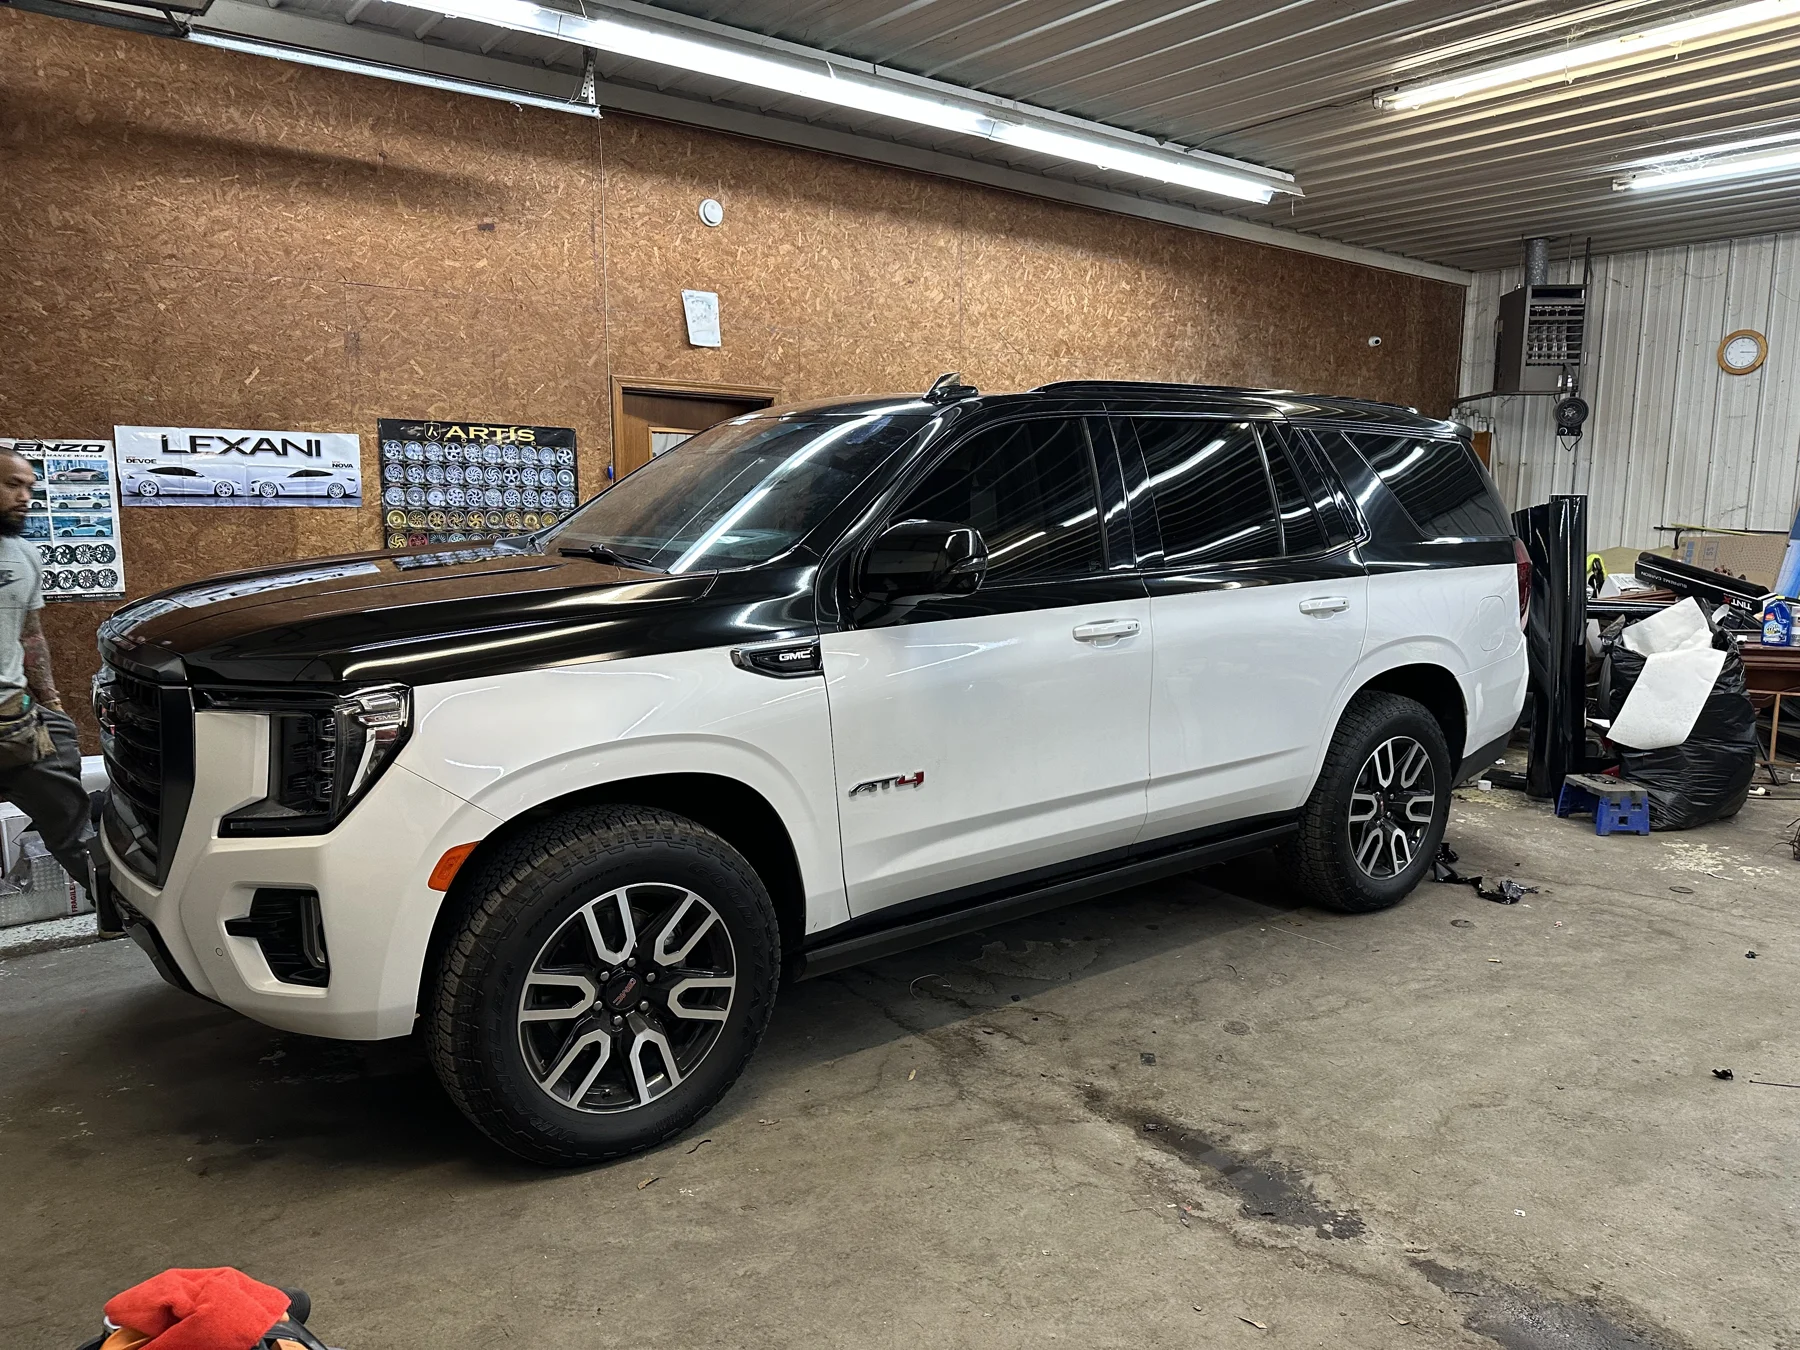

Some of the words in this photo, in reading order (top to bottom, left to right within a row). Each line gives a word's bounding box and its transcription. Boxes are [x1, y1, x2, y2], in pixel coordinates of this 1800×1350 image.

[161, 434, 321, 458] LEXANI
[444, 425, 536, 442] ARTIS
[778, 649, 811, 662] GMC
[848, 771, 925, 797] AT4
[70, 884, 78, 913] FRAGILE
[686, 861, 765, 1040] GOODYEAR
[612, 977, 637, 1006] GMC
[488, 958, 578, 1144] WRANGLER
